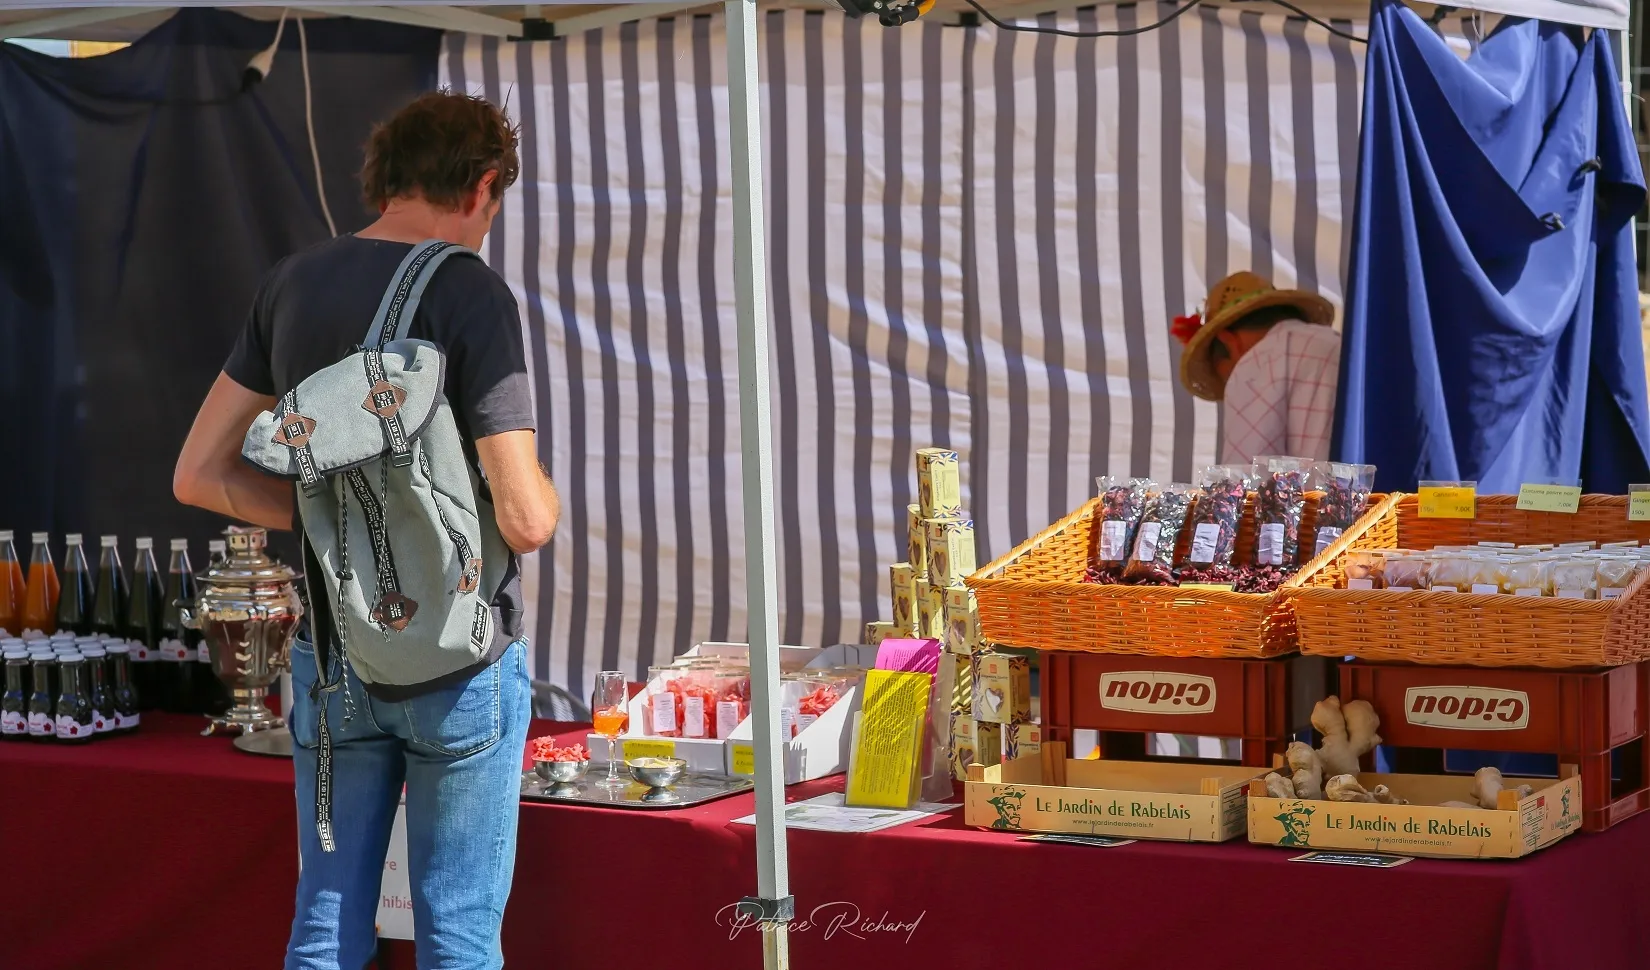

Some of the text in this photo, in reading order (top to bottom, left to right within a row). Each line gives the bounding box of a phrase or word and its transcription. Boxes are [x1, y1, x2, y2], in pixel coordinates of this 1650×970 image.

[1105, 680, 1211, 706] Cidou
[1411, 695, 1524, 723] Cidou
[1036, 797, 1191, 820] Le Jardin de Rabelais
[1326, 813, 1492, 838] Le Jardin de Rabelais
